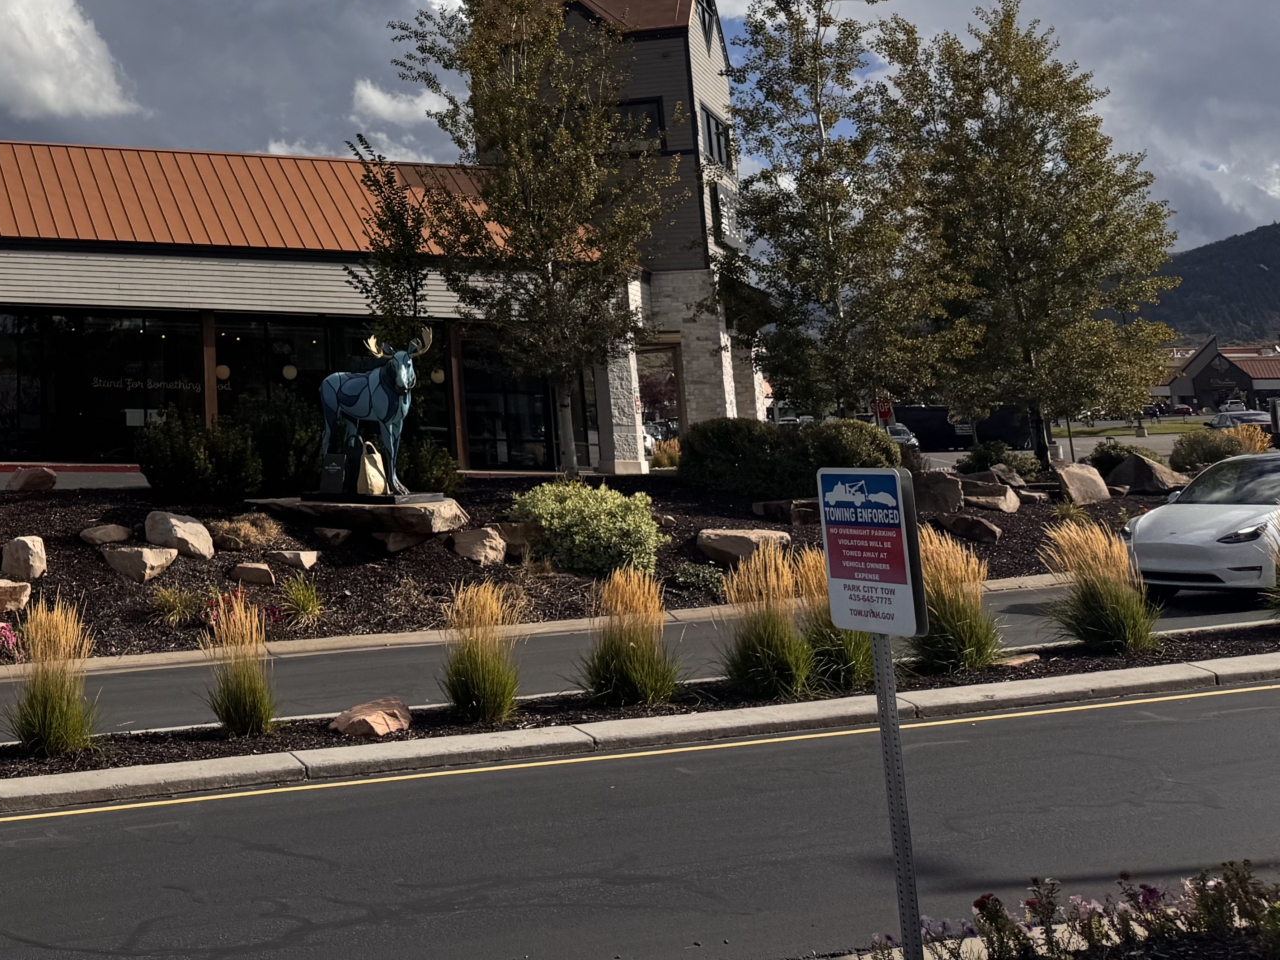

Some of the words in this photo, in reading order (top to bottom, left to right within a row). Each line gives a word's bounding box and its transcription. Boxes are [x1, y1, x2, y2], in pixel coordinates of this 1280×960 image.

[91, 377, 124, 389] Stand
[124, 377, 144, 392] For
[147, 379, 201, 392] Something
[825, 507, 855, 521] TOWING
[857, 508, 899, 523] ENFORCED
[838, 528, 870, 536] OVERNIGHT
[837, 539, 869, 547] VIOLATORS
[842, 549, 862, 557] TOWED
[842, 560, 866, 568] VEHICLE
[866, 562, 890, 570] OWNERS
[854, 572, 880, 580] EXPENSE
[843, 583, 861, 593] PARK
[862, 586, 878, 594] CITY
[880, 587, 896, 596] TOW
[848, 593, 892, 605] 435-645-7775
